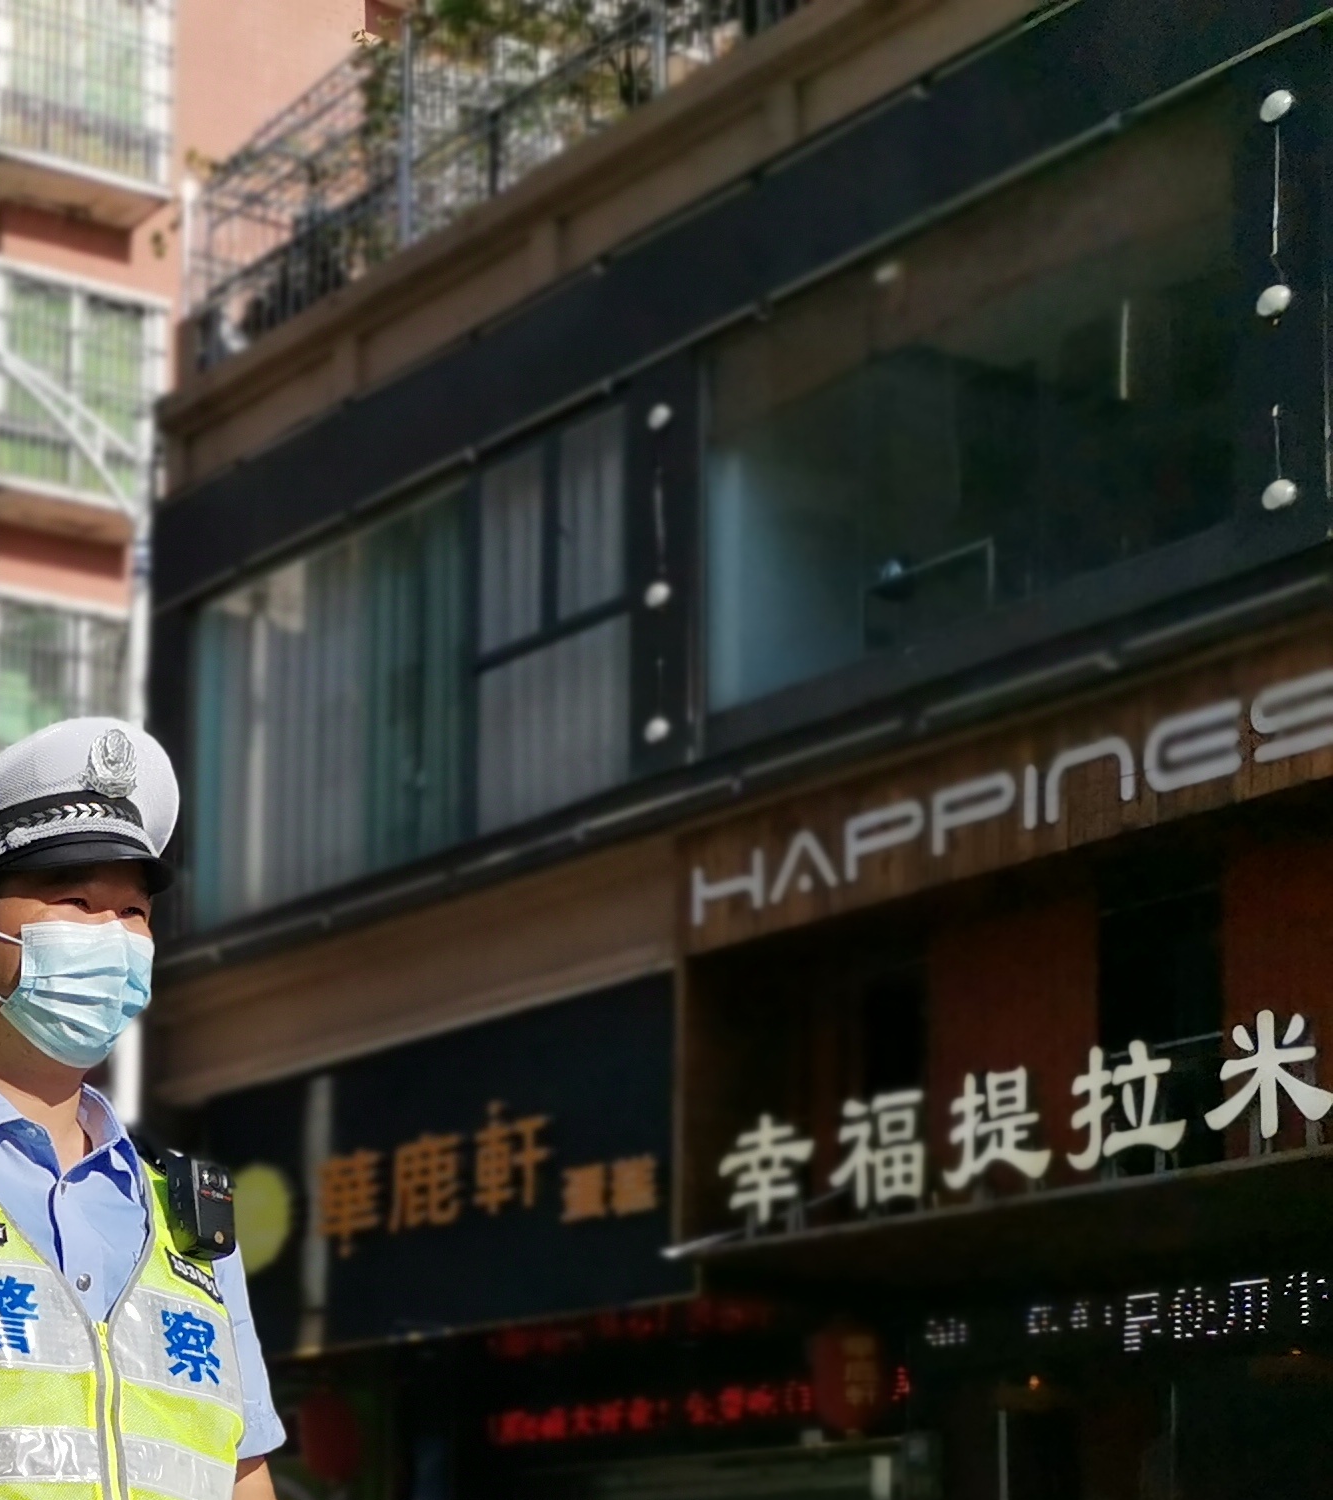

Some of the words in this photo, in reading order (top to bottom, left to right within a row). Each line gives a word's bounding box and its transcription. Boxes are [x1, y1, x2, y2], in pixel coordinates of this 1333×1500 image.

[719, 1008, 1333, 1221] 幸福提拉米
